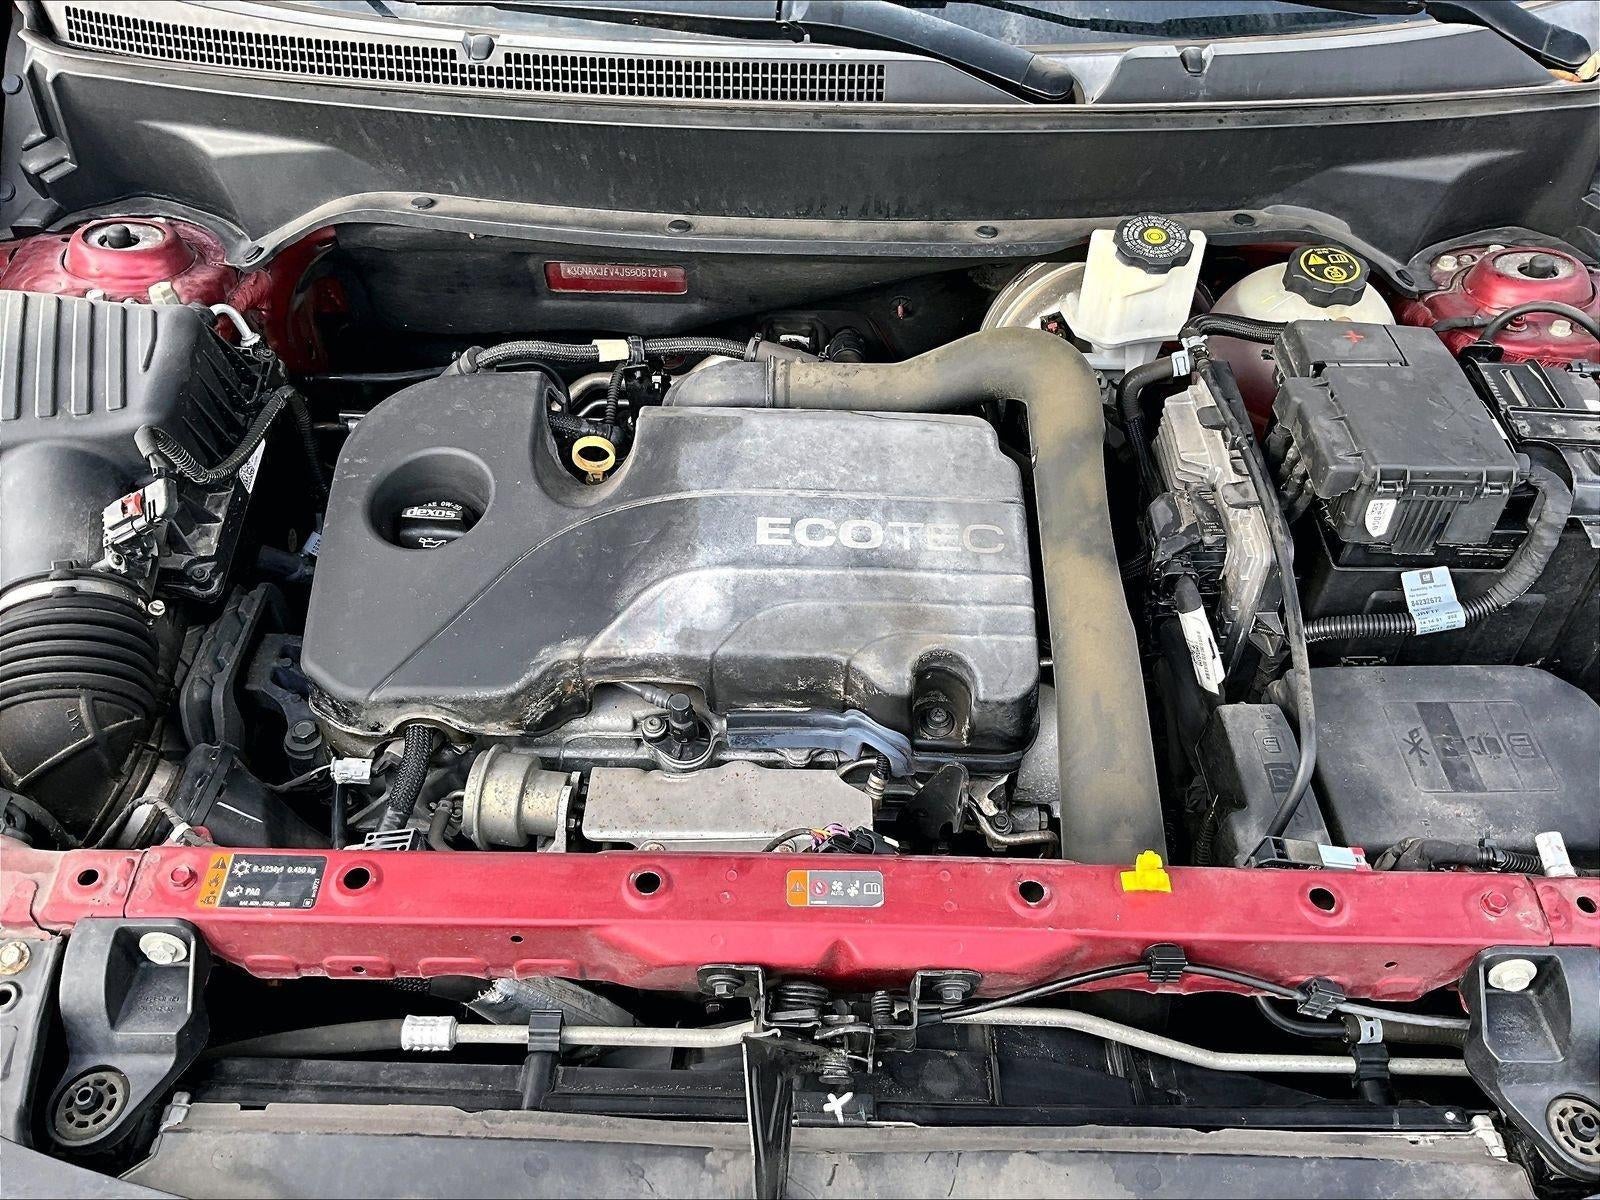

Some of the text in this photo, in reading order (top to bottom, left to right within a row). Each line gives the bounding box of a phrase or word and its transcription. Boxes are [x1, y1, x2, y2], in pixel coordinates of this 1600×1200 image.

[406, 506, 457, 518] dexos
[756, 516, 1006, 554] ECOTEC
[307, 867, 317, 875] kg
